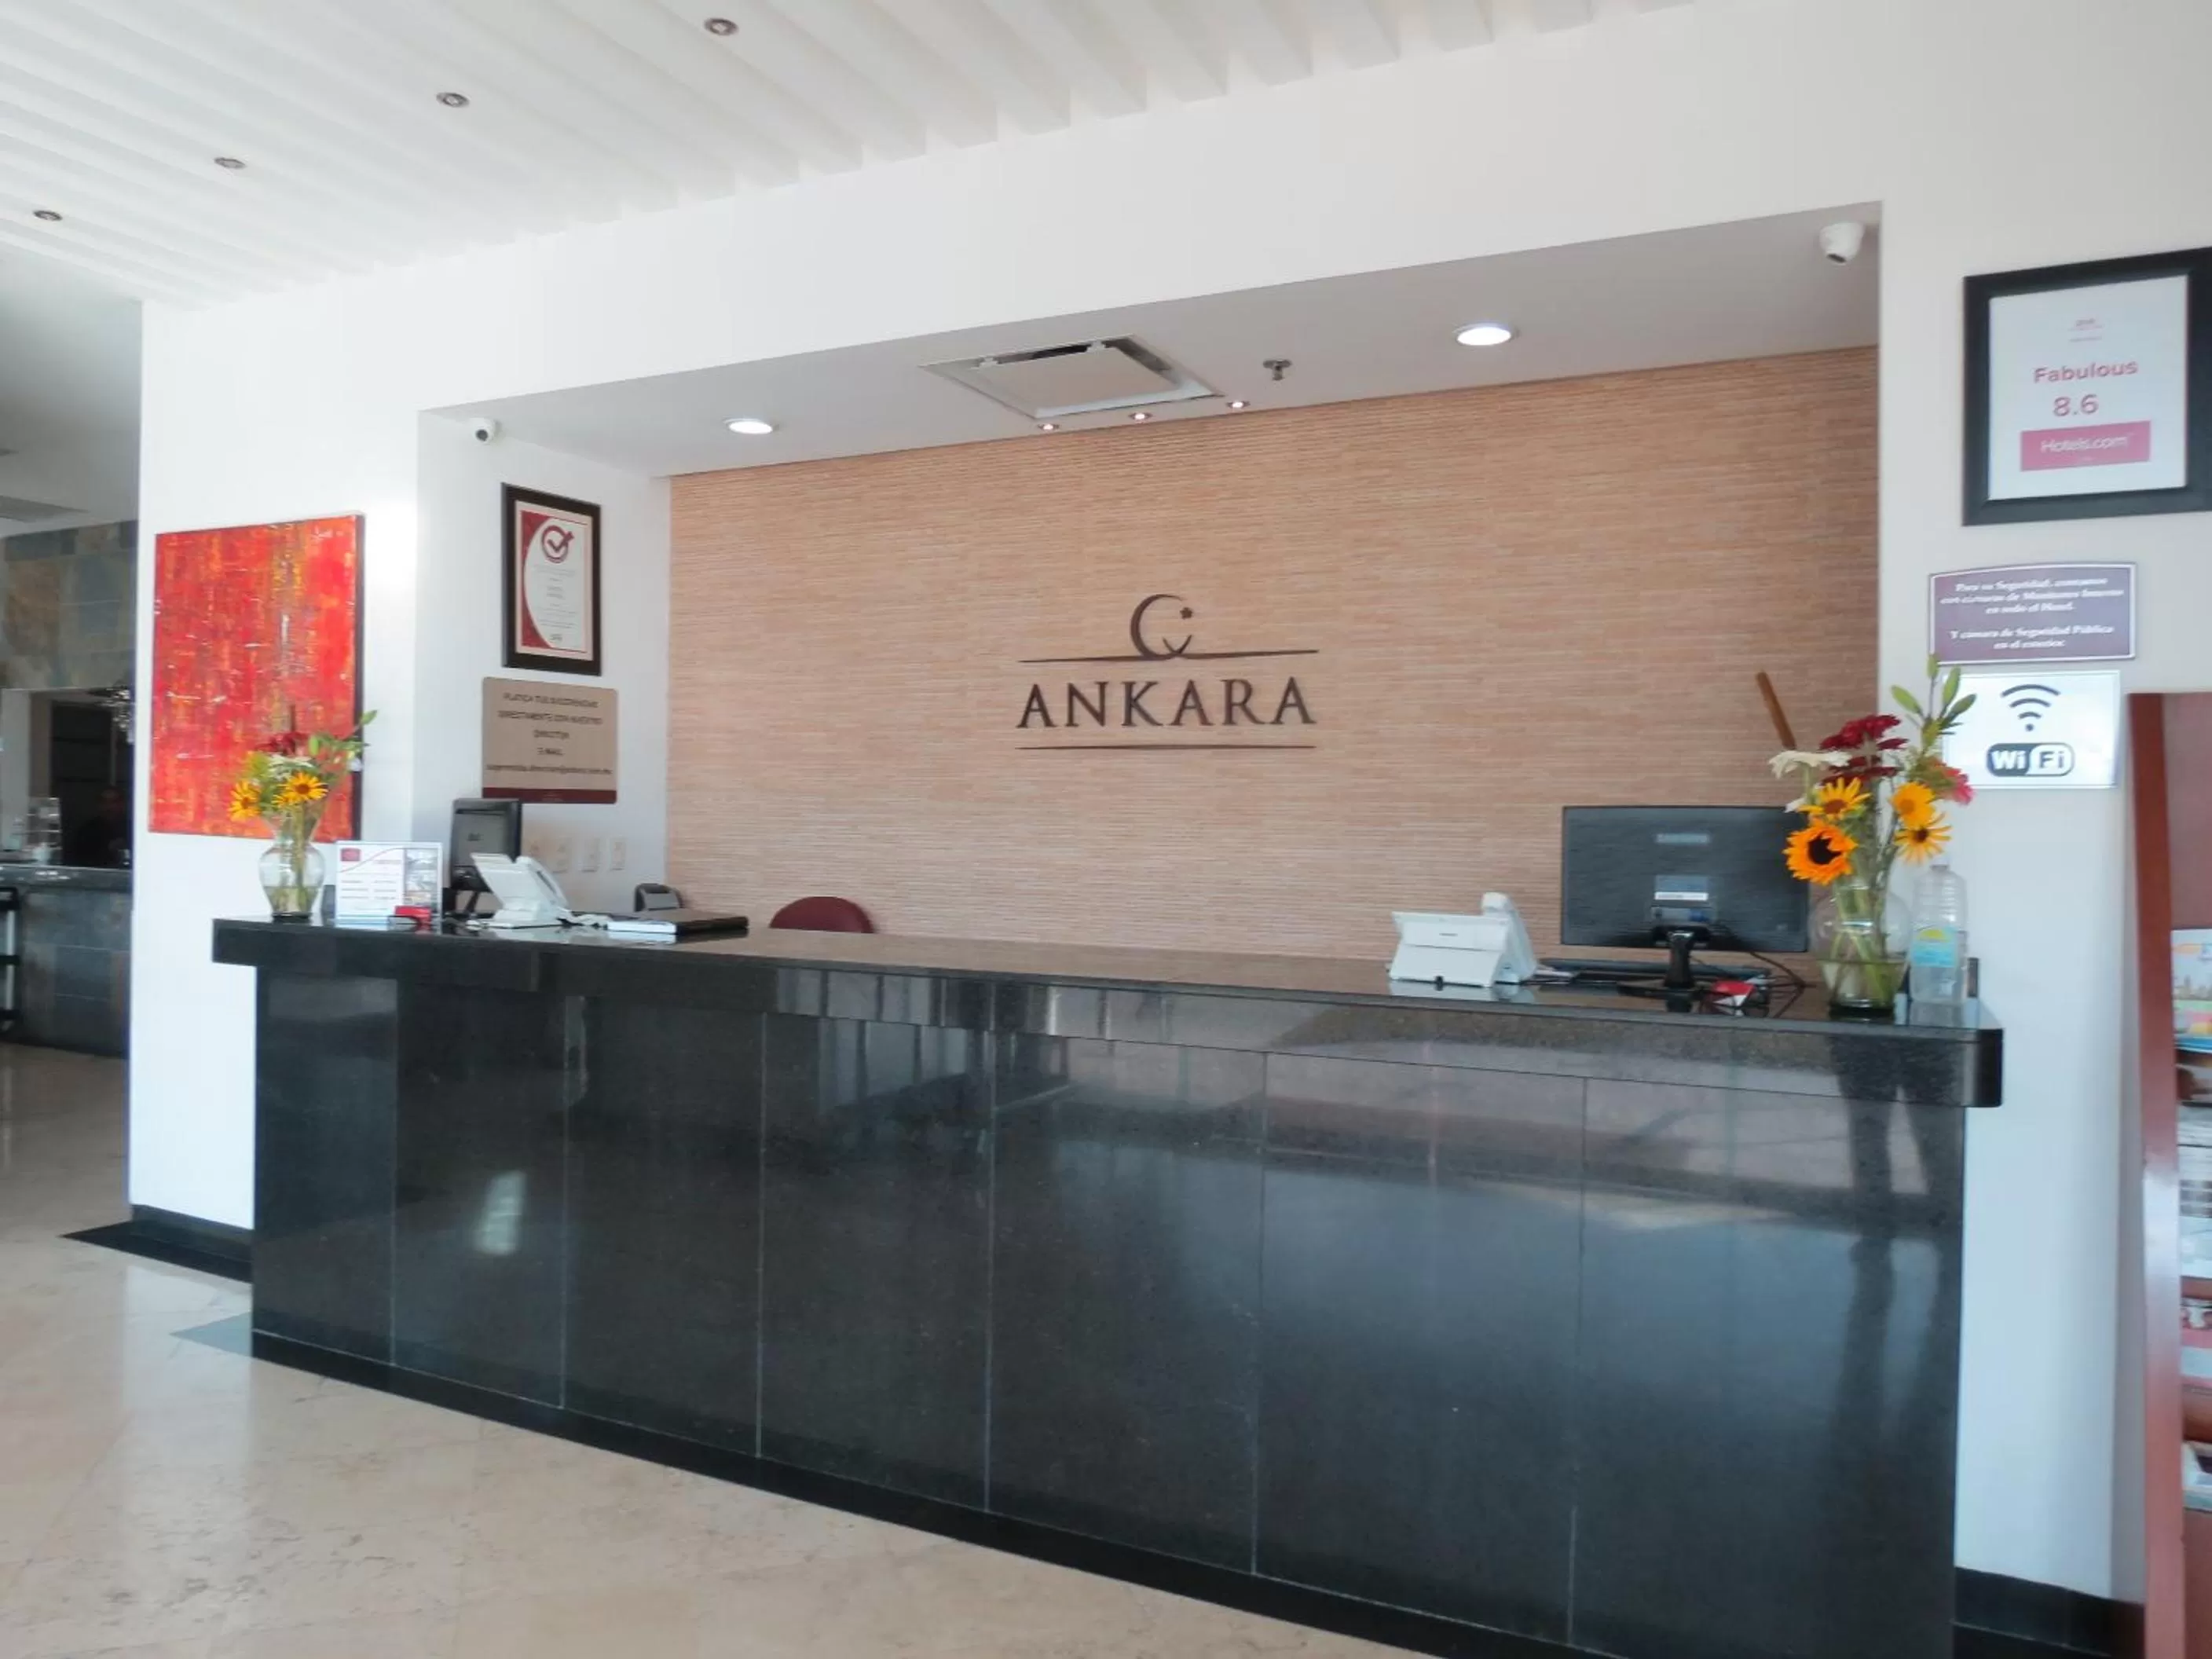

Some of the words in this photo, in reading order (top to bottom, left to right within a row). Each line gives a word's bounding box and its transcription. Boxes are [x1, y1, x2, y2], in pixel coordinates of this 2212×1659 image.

[2033, 361, 2138, 383] Fabulous
[2053, 394, 2099, 417] 8.6
[2040, 434, 2129, 454] Hotels.com
[1016, 676, 1317, 729] ANKARA
